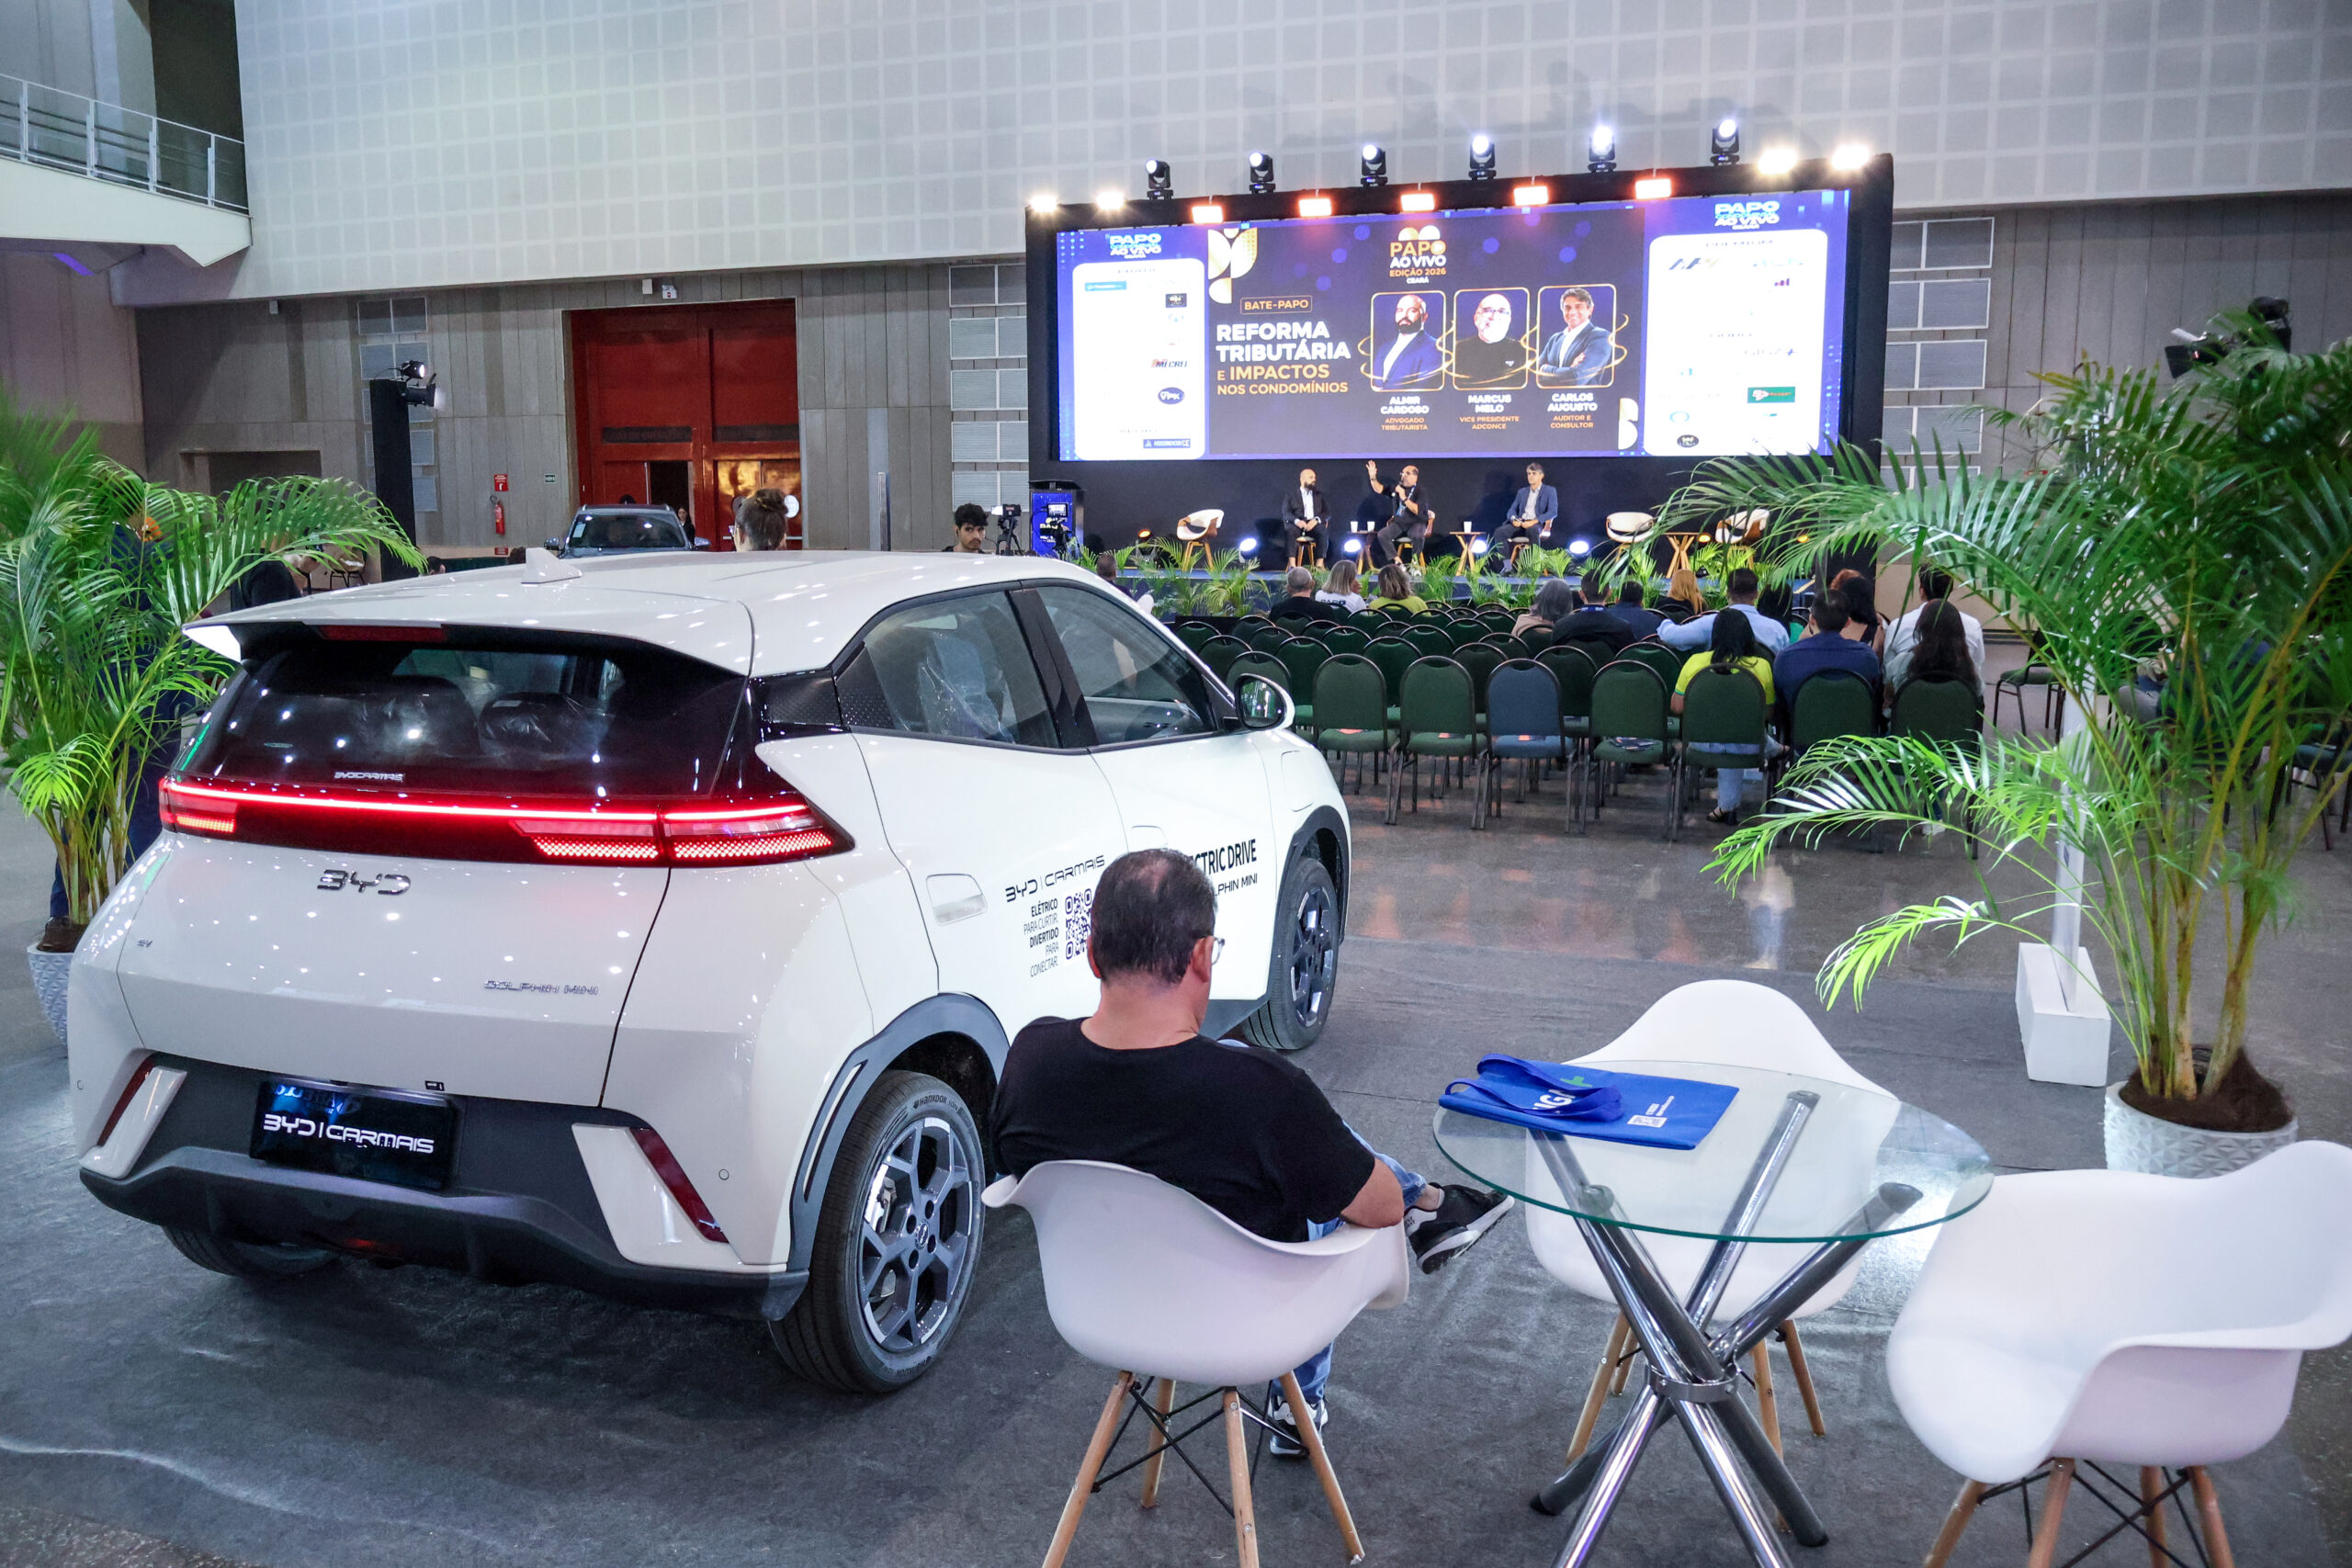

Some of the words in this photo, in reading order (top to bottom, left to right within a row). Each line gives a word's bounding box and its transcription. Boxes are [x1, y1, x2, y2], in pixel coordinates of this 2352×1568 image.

[1714, 201, 1781, 215] PAPO
[1739, 214, 1781, 226] VIVO
[1109, 233, 1162, 245] PAPO
[1129, 244, 1162, 255] VIVO
[1389, 240, 1446, 258] PAPO
[1389, 256, 1411, 269] AO
[1412, 254, 1447, 268] VIVO
[1389, 267, 1423, 278] EDIÇÃO
[1424, 267, 1446, 276] 2026
[1244, 299, 1309, 311] BATE-PAPO
[1216, 321, 1330, 343] REFORMA
[1215, 337, 1351, 363] TRIBUTÁRIA
[1216, 369, 1227, 381] E
[1229, 363, 1330, 381] IMPACTOS
[1216, 384, 1246, 396] NOS
[1248, 378, 1349, 395] CONDOMÍNIOS
[1388, 395, 1420, 406] ALMIR
[1467, 393, 1512, 405] MARCUS
[1551, 392, 1594, 402] CARLOS
[1380, 405, 1430, 415] CARDOSO
[1475, 403, 1505, 413] MELO
[1546, 401, 1599, 412] AUGUSTO
[1459, 415, 1476, 423] VICE
[1476, 414, 1521, 423] PRESIDENTE
[1553, 414, 1586, 423] AUDITOR
[1472, 423, 1507, 431] ADCONCE
[1550, 422, 1595, 430] CONSULTOR
[1227, 838, 1257, 869] DRIVE
[317, 869, 411, 896] BYD
[1005, 878, 1038, 903] BYD
[1044, 854, 1105, 887] CARMAIS
[1240, 873, 1258, 888] MINI
[1031, 897, 1058, 918] ELÉTRICO
[1023, 919, 1038, 935] PARA
[1029, 927, 1059, 948] DIVERTIDO
[1045, 941, 1058, 956] PARA
[263, 1113, 316, 1137] BYD
[325, 1124, 435, 1154] CARMAIS
